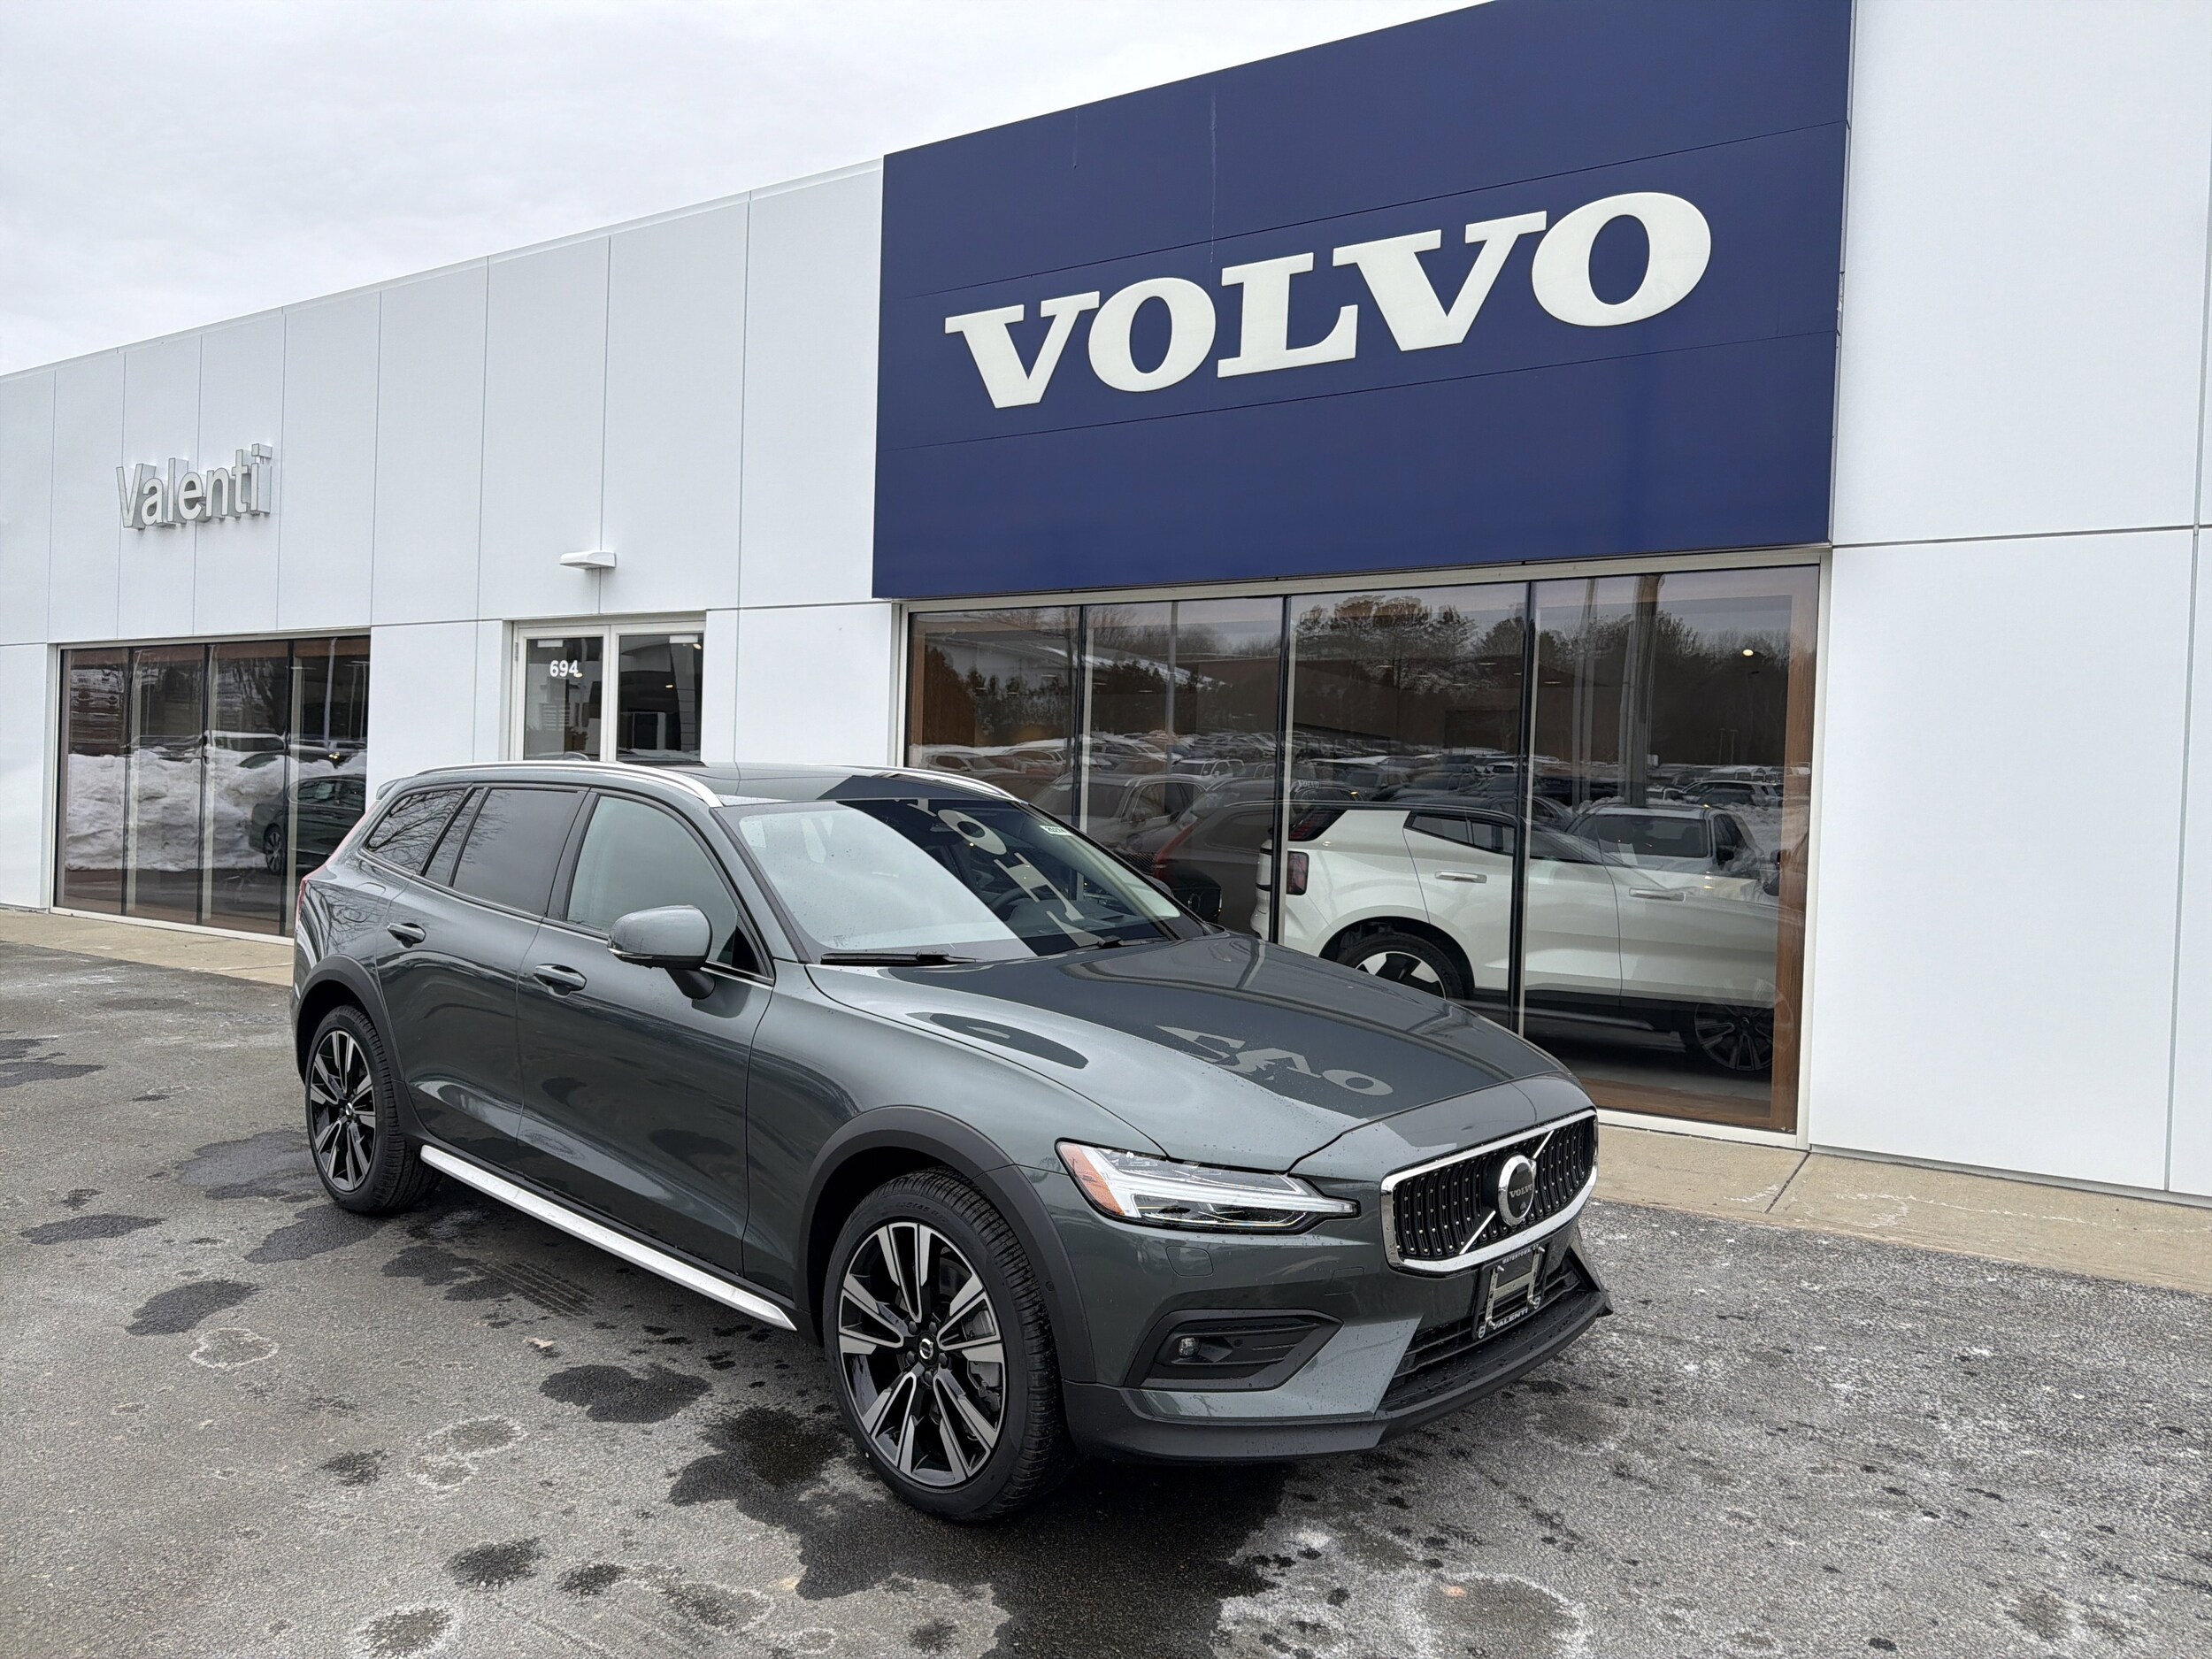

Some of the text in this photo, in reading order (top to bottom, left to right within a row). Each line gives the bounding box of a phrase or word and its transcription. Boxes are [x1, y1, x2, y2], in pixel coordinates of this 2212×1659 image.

[945, 192, 1711, 409] VOLVO
[116, 443, 269, 529] Valenti
[549, 659, 579, 678] 694
[1509, 1183, 1532, 1198] VOLV
